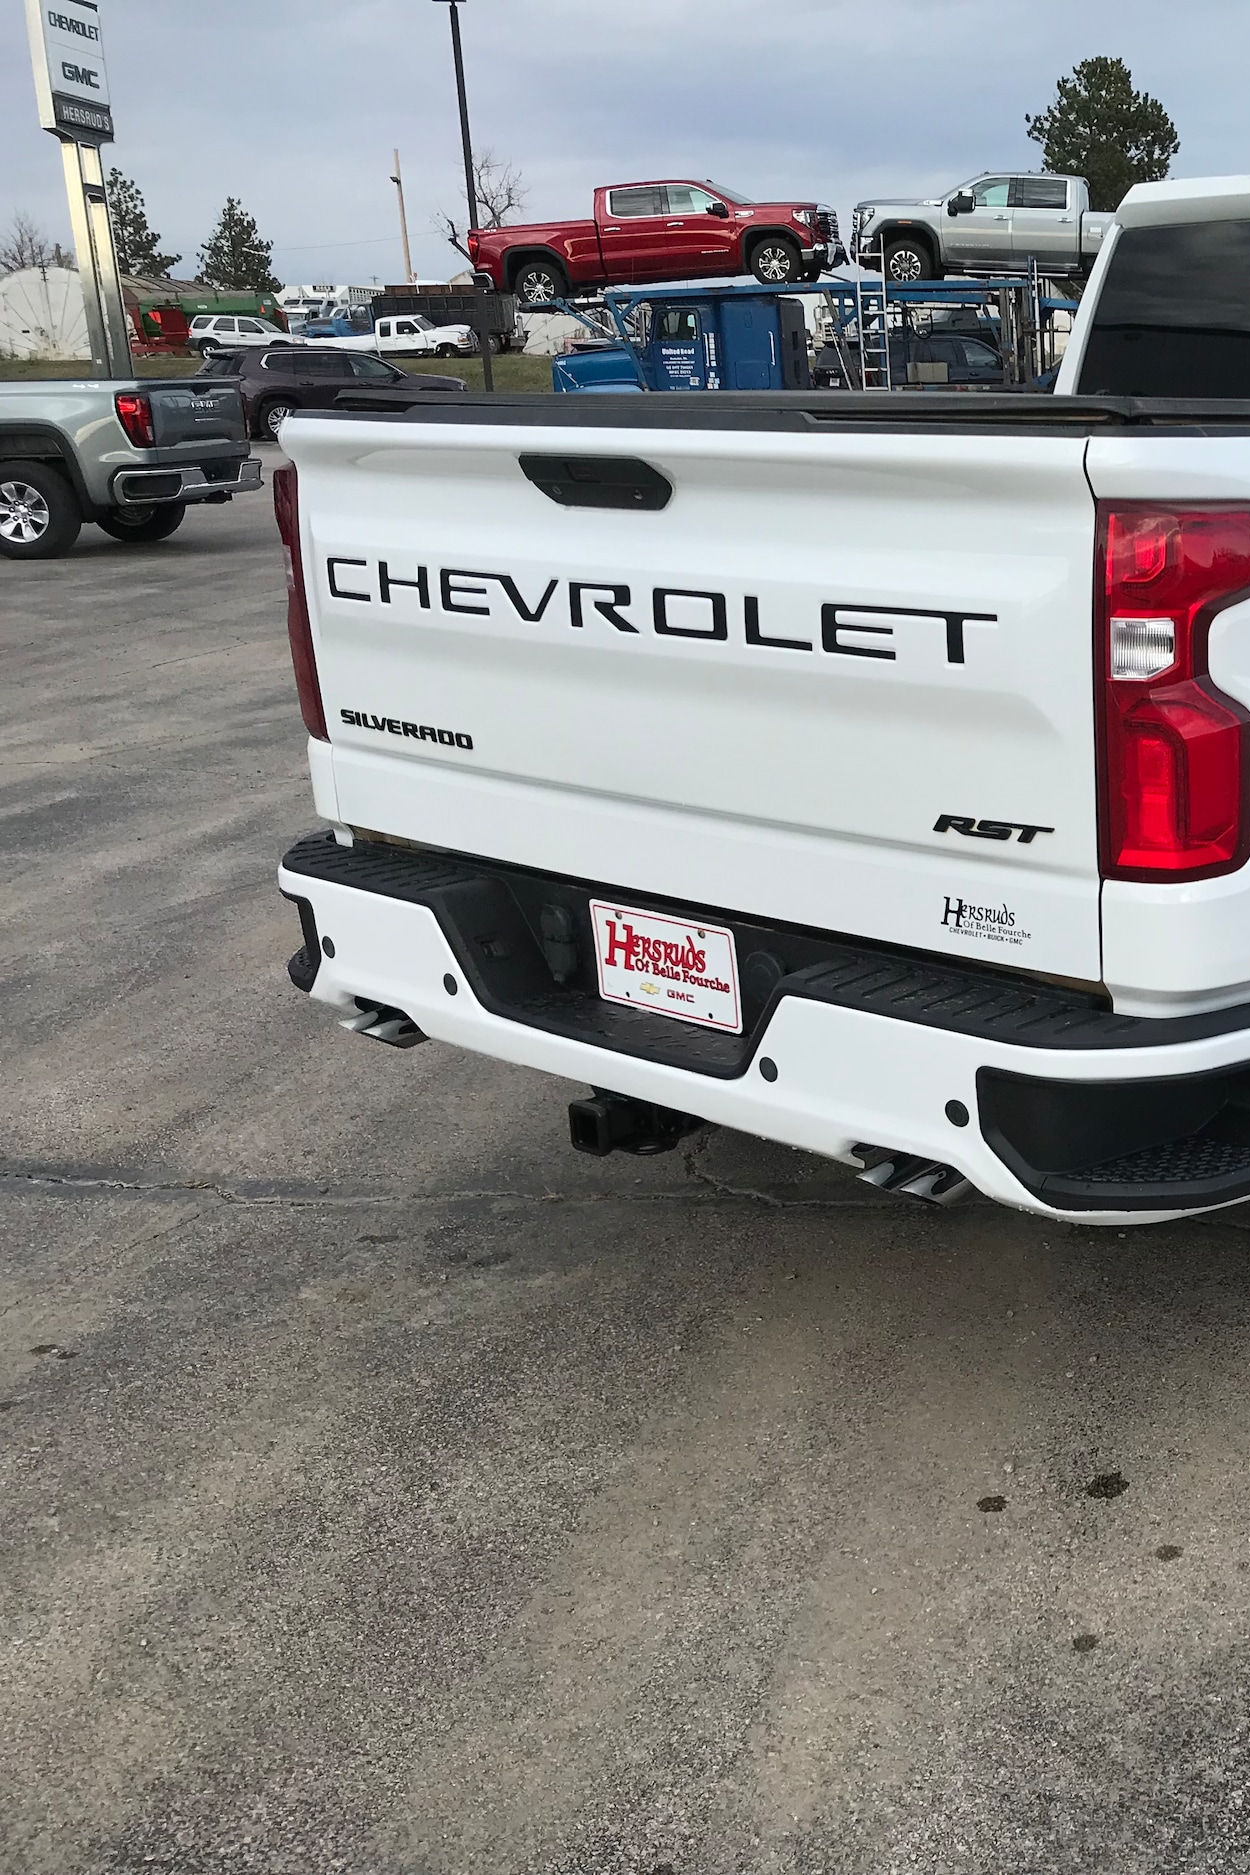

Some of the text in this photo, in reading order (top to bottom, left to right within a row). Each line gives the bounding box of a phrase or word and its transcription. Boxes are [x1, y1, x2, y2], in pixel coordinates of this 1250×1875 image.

[48, 11, 99, 41] CHEVROLET
[62, 61, 100, 89] GMC
[62, 105, 110, 131] HERSRUD'S
[326, 557, 998, 665] CHEVROLET
[340, 708, 474, 750] SILVERADO
[932, 814, 1055, 844] RST
[949, 927, 1023, 945] CHEVROLET BUICK GMC
[963, 920, 1031, 939] Of Belle Fourche
[635, 959, 731, 994] Of Belle Fourche
[667, 989, 695, 1003] GMC
